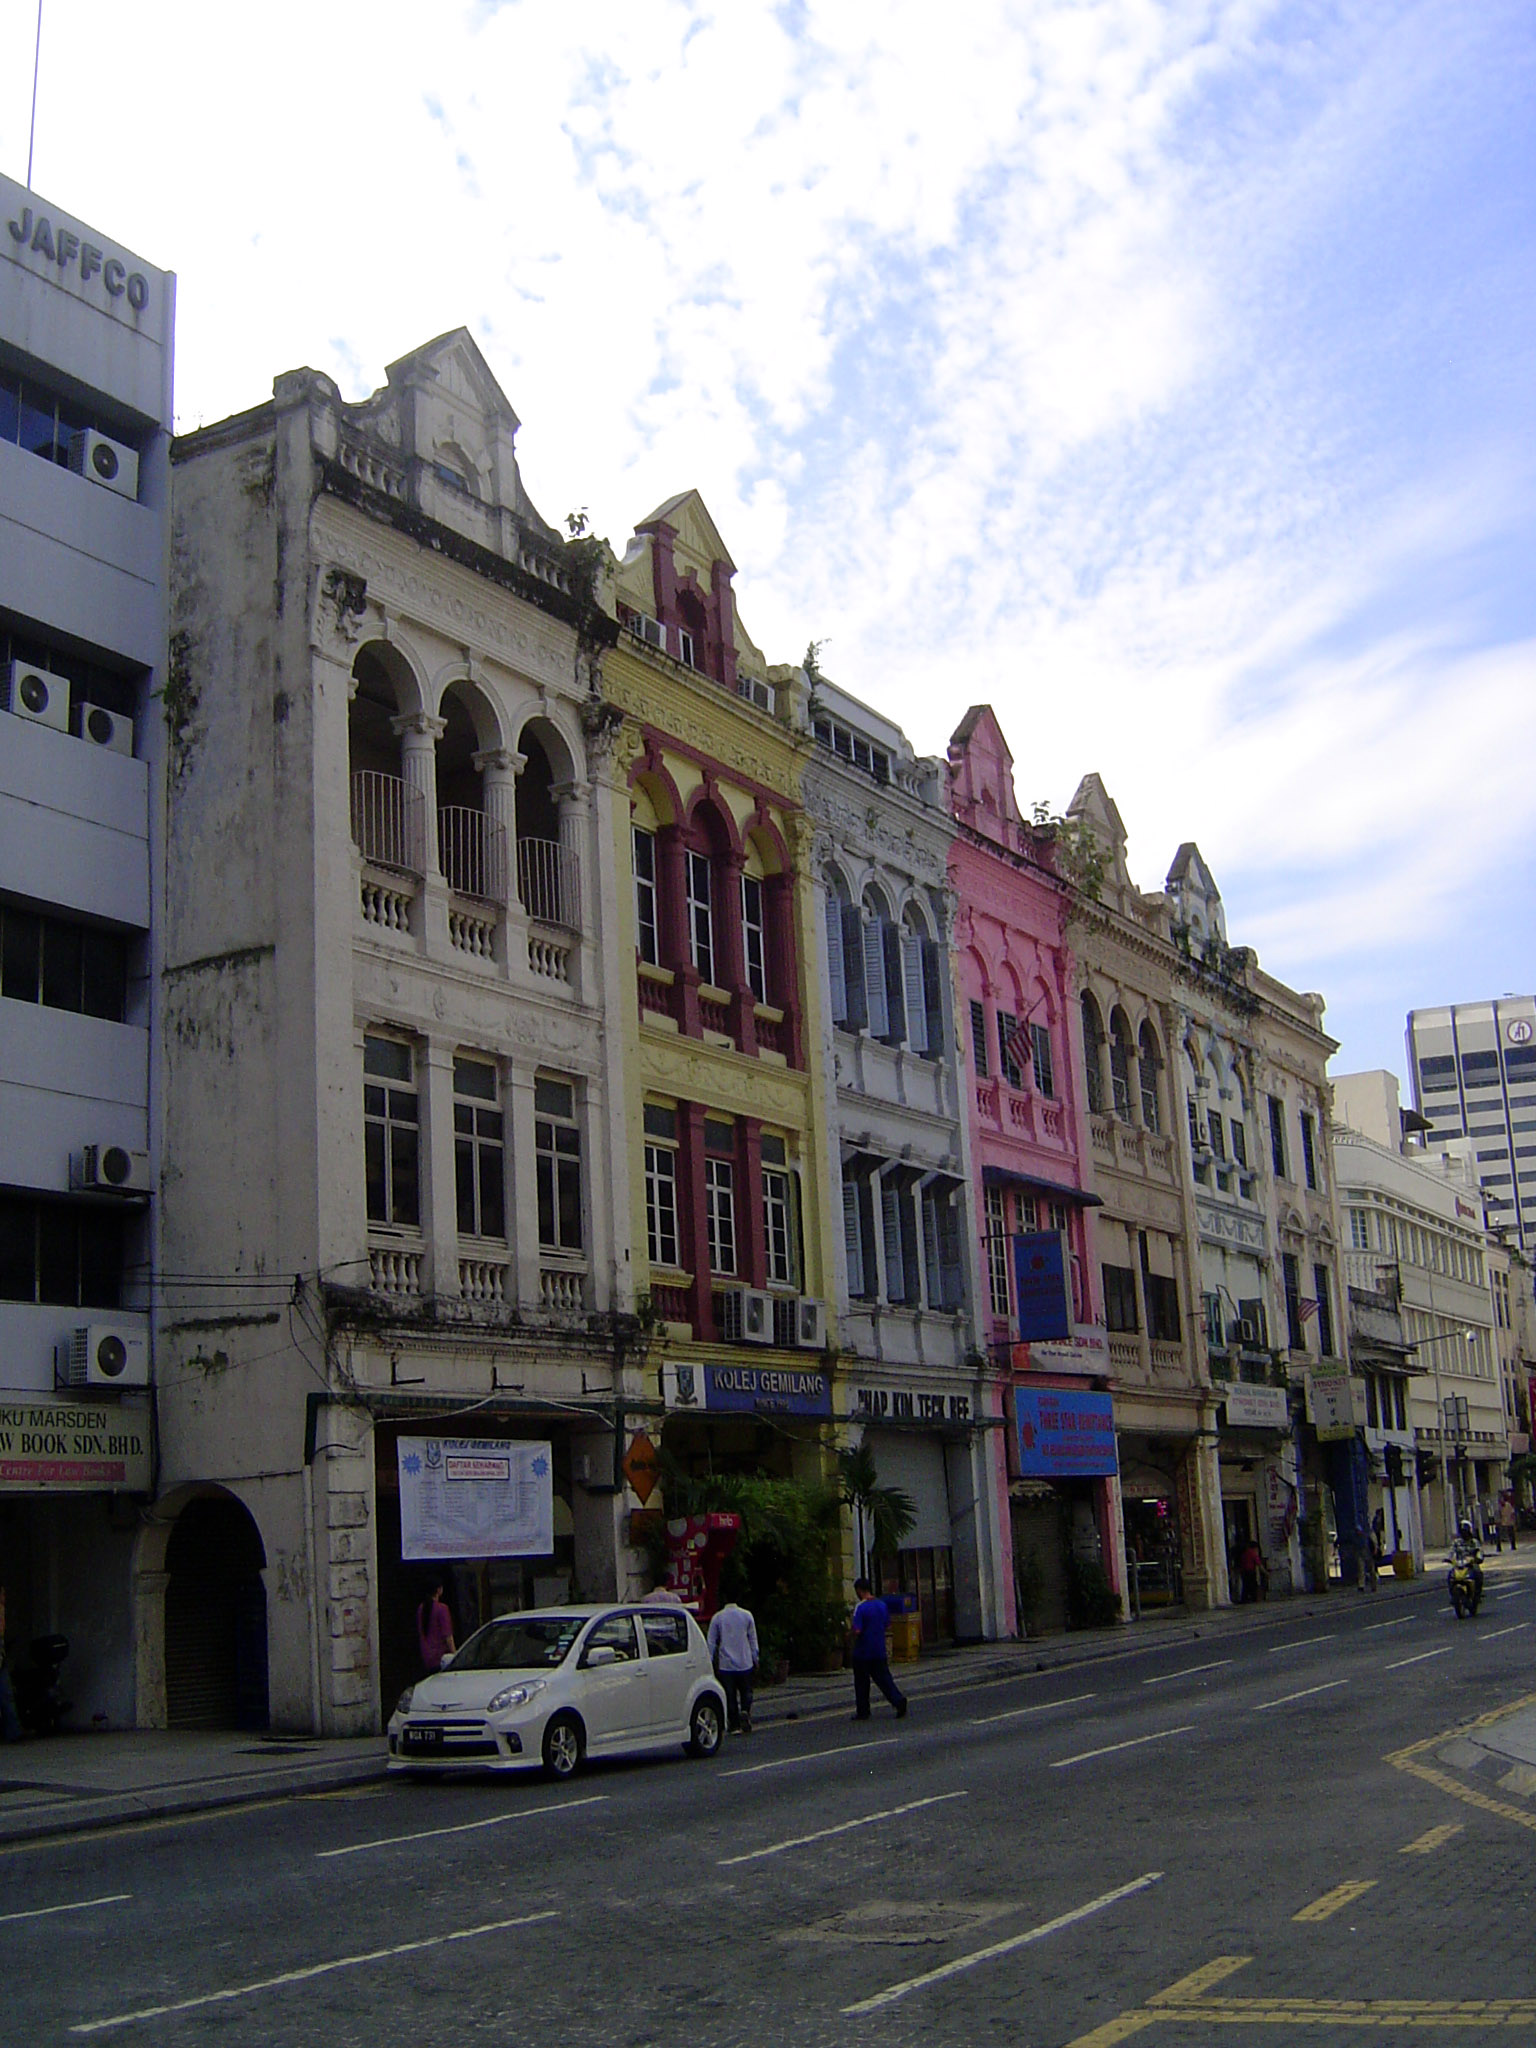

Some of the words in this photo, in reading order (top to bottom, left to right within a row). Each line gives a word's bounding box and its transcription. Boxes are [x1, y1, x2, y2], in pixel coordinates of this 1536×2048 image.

[9, 207, 150, 311] JAFFCO
[715, 1369, 757, 1391] KOLEJ
[761, 1373, 824, 1394] GEMILANG
[29, 1411, 107, 1429] MARSDEN
[22, 1434, 67, 1454] BOOK
